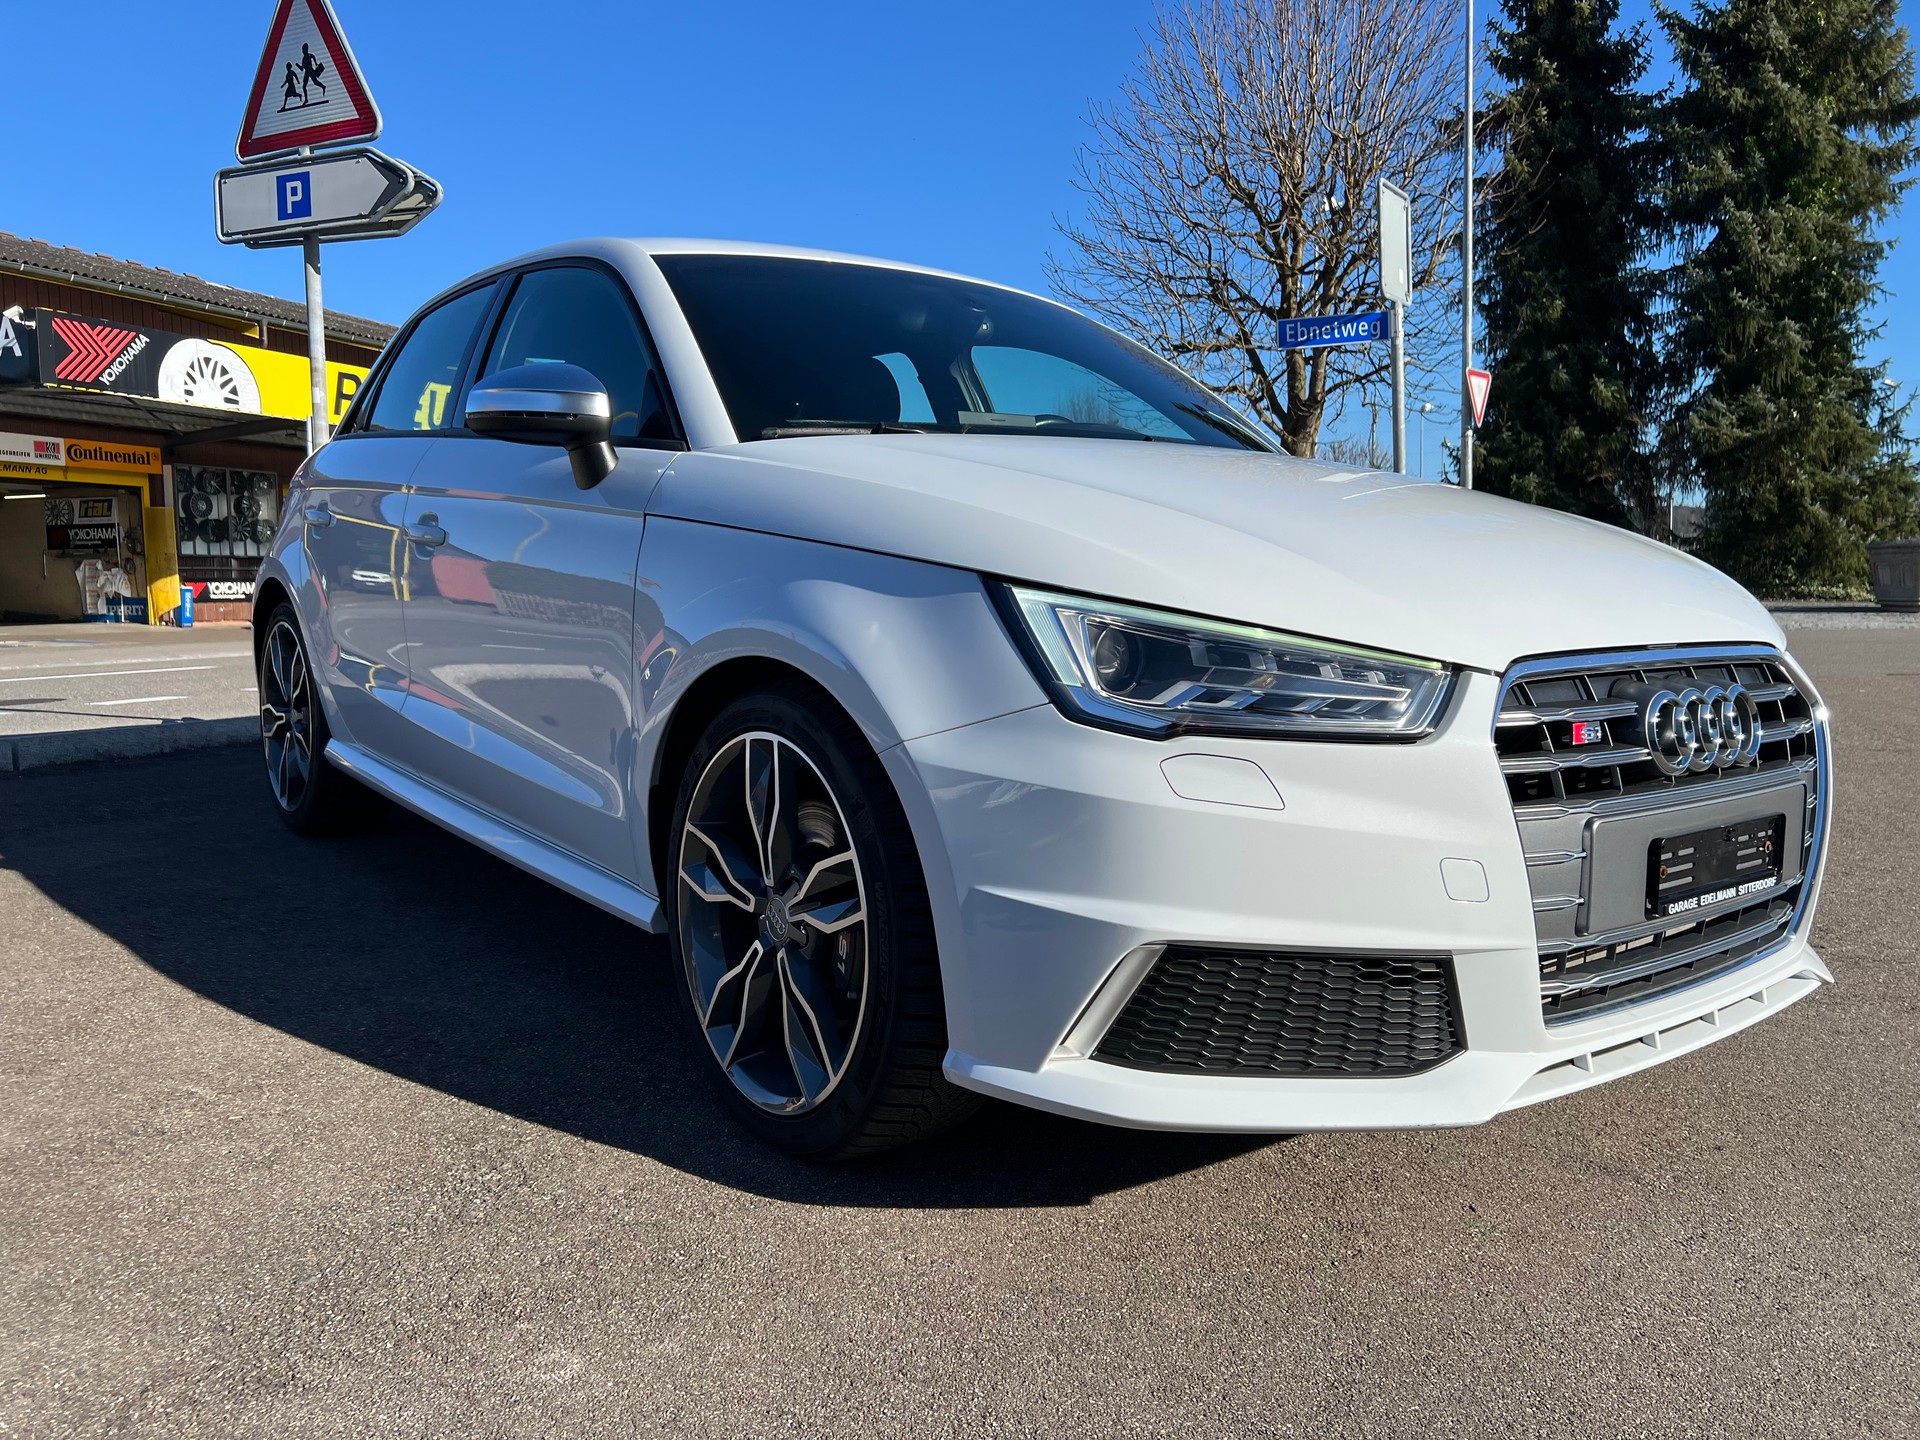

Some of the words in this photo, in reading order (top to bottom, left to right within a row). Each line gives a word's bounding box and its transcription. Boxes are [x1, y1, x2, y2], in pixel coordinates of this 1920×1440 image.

[286, 180, 302, 214] P
[1286, 320, 1380, 342] Ebnetweg
[99, 333, 150, 385] YOKOHAMA
[34, 452, 61, 460] UNIROYAL
[66, 443, 151, 465] Continental
[34, 466, 48, 475] AG
[68, 527, 116, 541] YOKOHAMA
[207, 581, 256, 595] YOKOHAM
[1668, 897, 1698, 915] GARAGE
[1700, 886, 1736, 906] EDELMANN
[1738, 876, 1777, 896] SITTERDORF
[837, 935, 847, 974] S1
